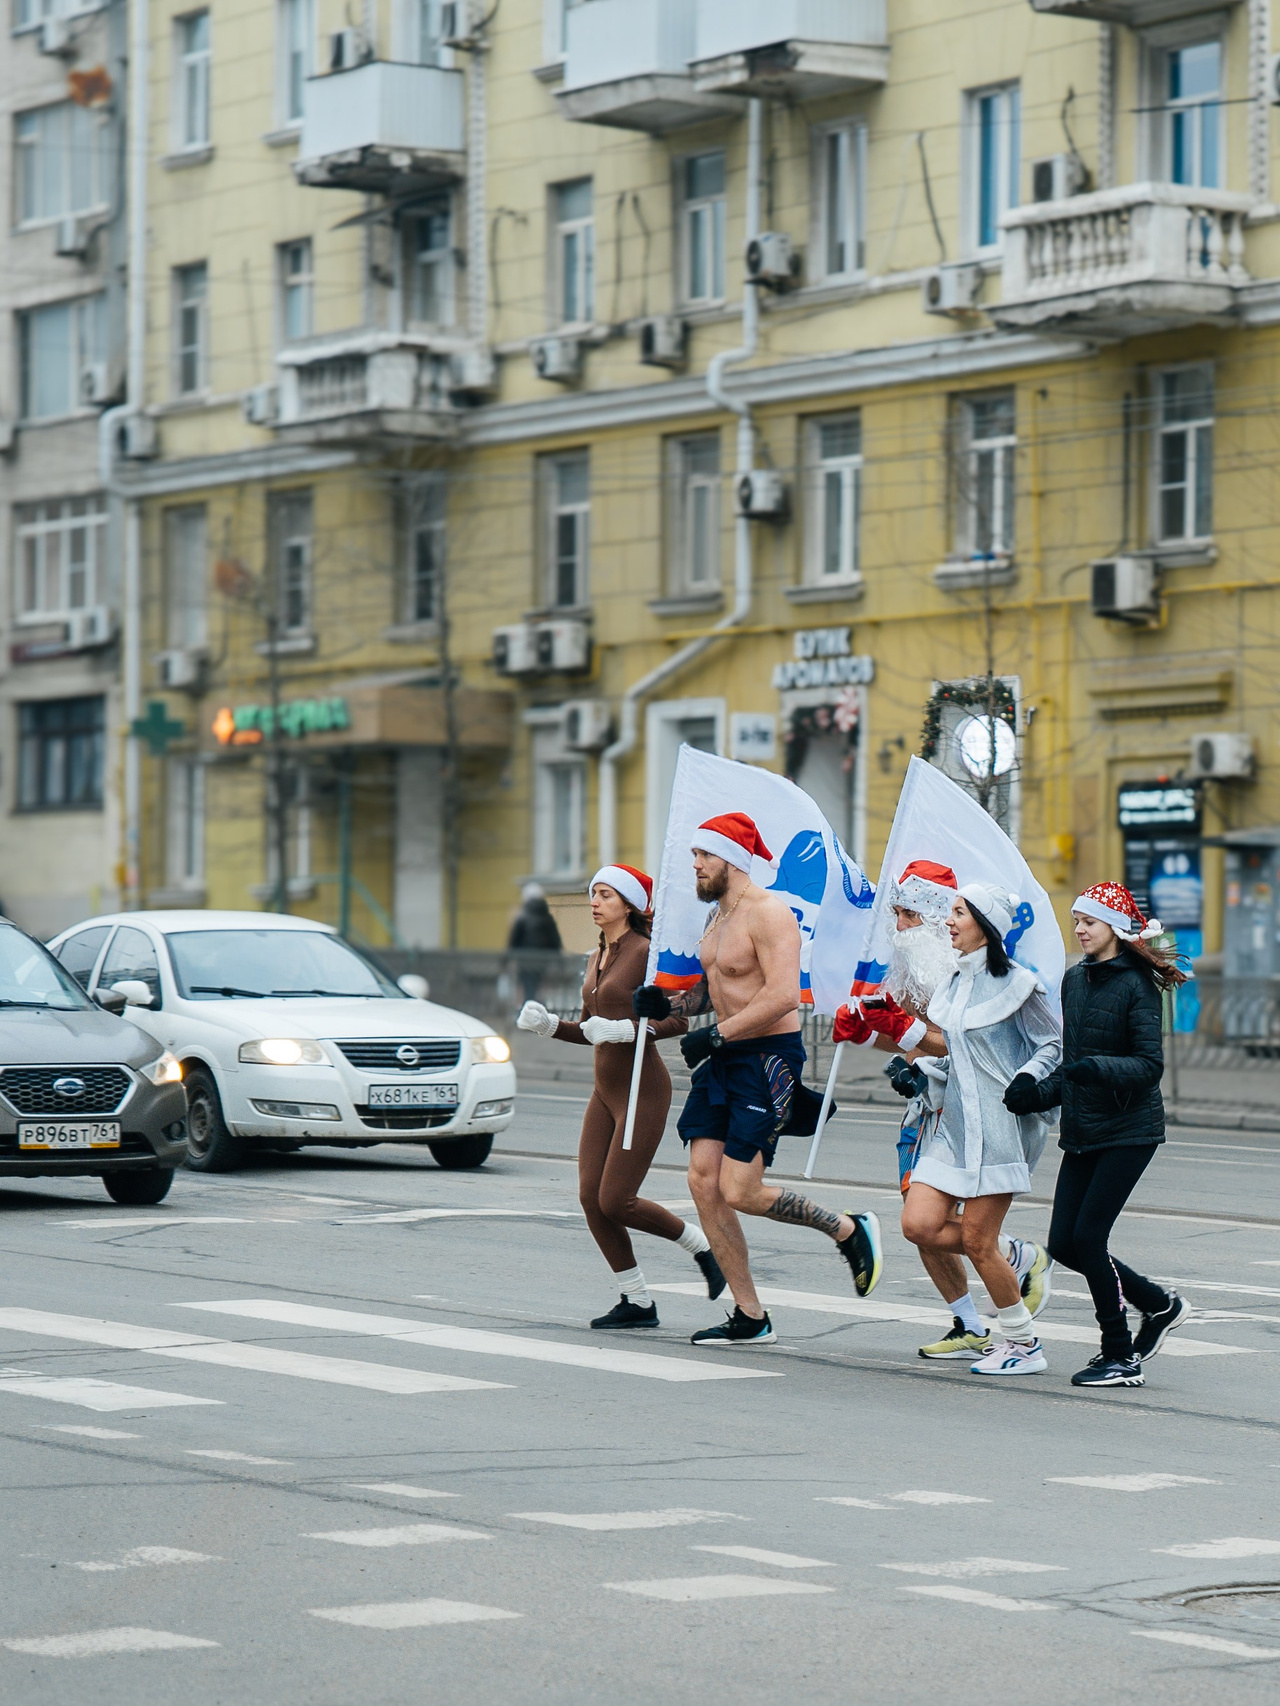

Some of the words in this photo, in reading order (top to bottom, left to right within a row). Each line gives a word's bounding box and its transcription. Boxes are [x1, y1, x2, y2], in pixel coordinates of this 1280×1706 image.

[432, 1087, 454, 1098] 161
[24, 1126, 89, 1143] Р896ВТ
[91, 1124, 117, 1138] 761
